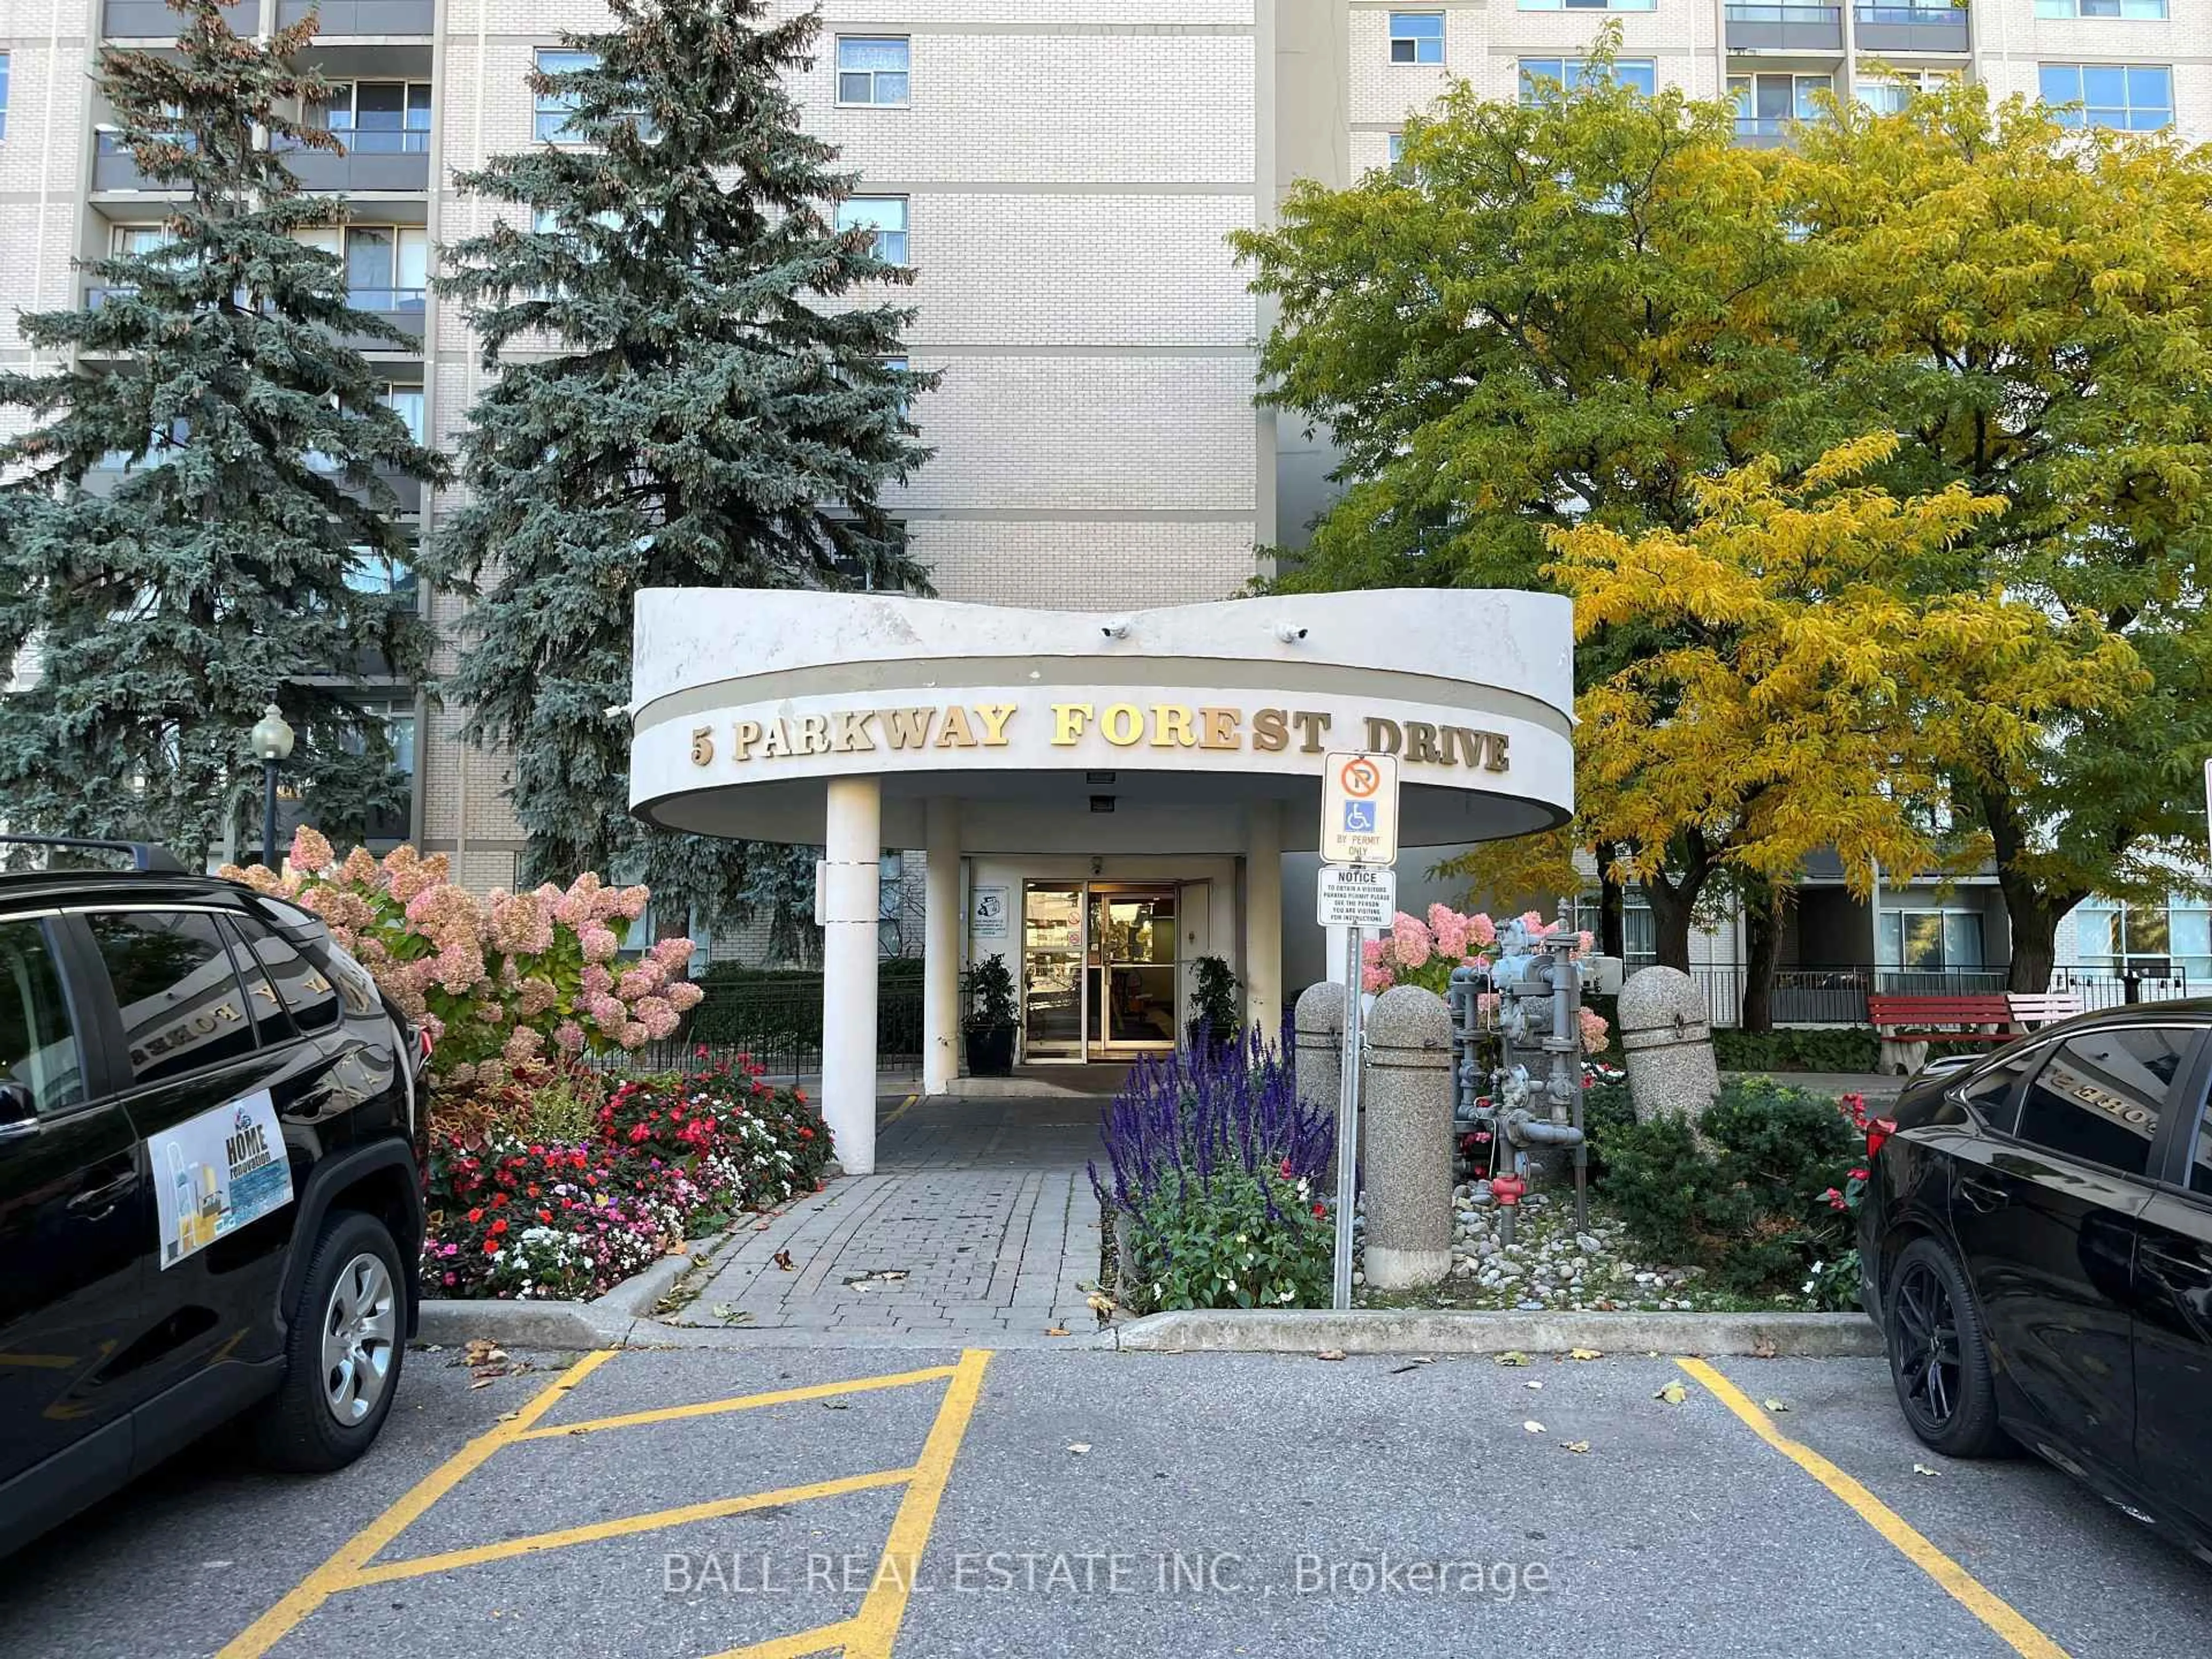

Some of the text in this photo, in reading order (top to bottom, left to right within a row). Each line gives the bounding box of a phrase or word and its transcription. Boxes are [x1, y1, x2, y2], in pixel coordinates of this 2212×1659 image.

[691, 703, 1511, 772] 5 PARKWAY FOREST DRIVE
[1336, 834, 1380, 845] BY PERMIT
[1349, 846, 1368, 855] ONLY
[1338, 872, 1377, 883] NOTICE
[226, 1124, 268, 1166] HOME
[230, 1152, 271, 1180] renovation
